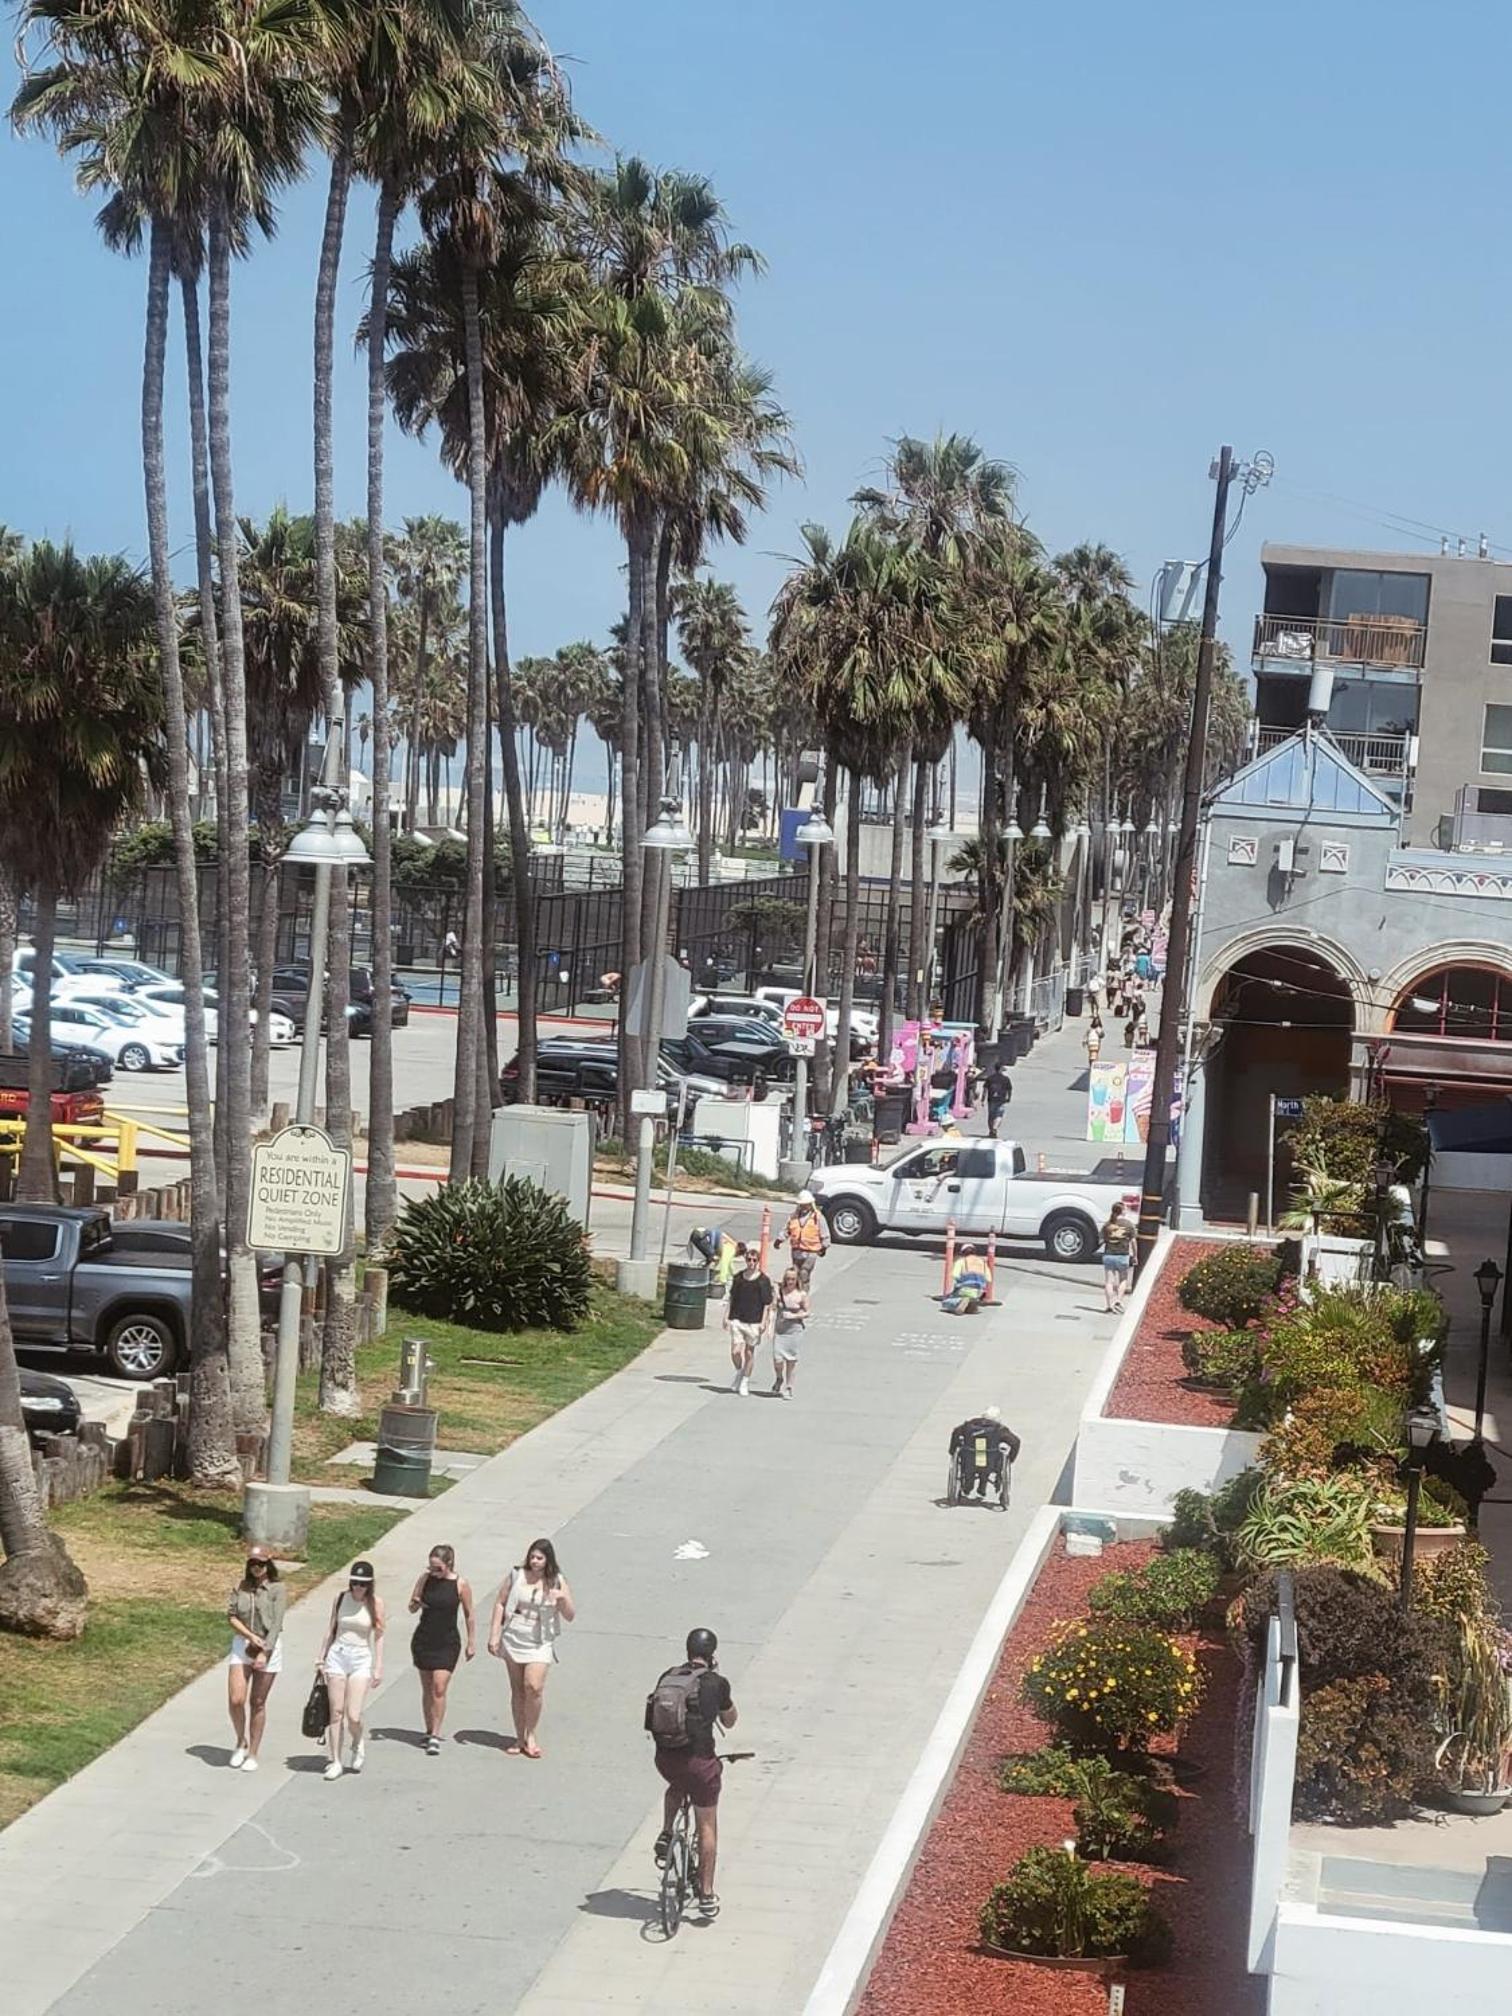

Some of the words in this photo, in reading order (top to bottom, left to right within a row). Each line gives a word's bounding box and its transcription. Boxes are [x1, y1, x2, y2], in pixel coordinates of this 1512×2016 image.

[803, 1005, 818, 1013] NOT
[1277, 1100, 1299, 1109] North
[266, 1151, 283, 1161] You
[286, 1154, 300, 1162] are
[302, 1153, 329, 1165] within
[260, 1166, 341, 1189] RESIDENTIAL
[258, 1187, 299, 1204] QUIET
[302, 1190, 339, 1207] ZONE
[304, 1208, 322, 1218] Only
[265, 1215, 276, 1223] No
[264, 1223, 276, 1231] No
[263, 1231, 276, 1240] No
[278, 1232, 312, 1244] Camping
